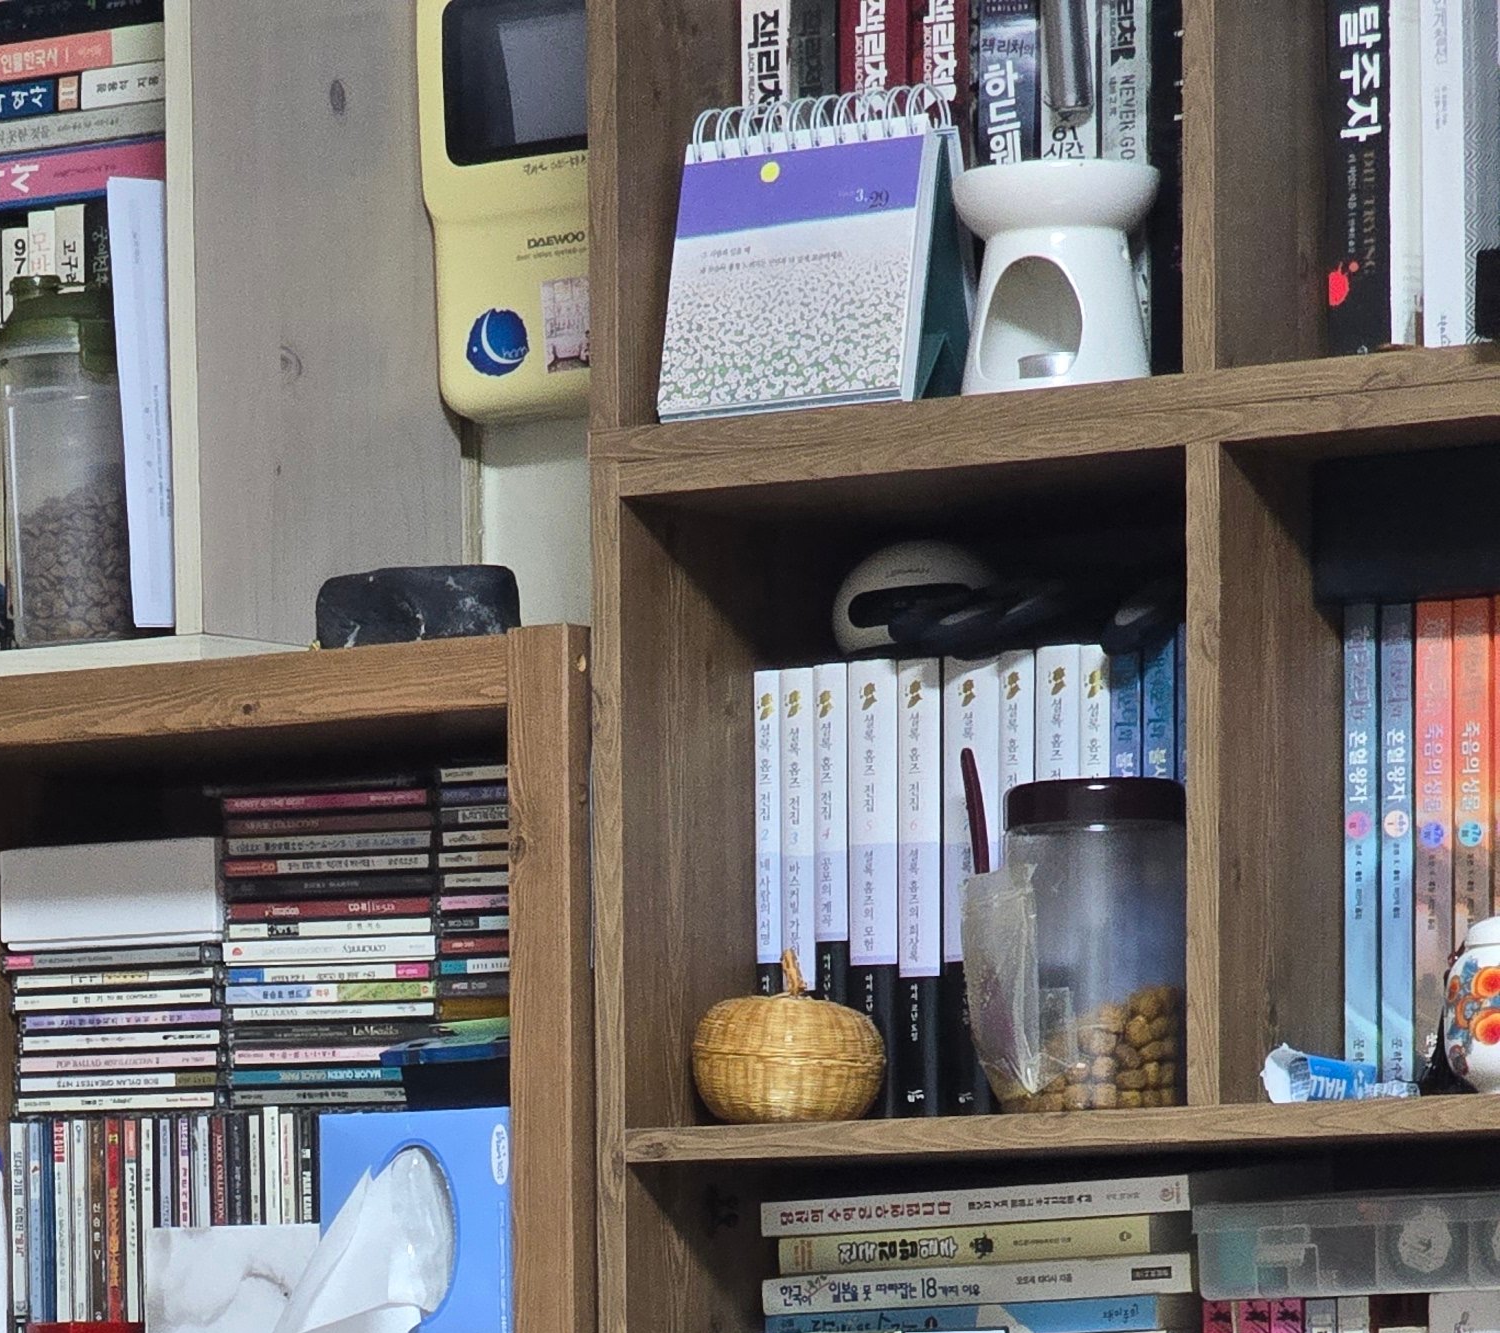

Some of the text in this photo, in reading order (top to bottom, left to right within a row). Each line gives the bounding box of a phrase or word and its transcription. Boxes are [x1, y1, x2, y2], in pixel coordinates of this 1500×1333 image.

[1339, 5, 1382, 142] 탈주자
[12, 86, 47, 109] 역사
[1119, 74, 1136, 132] NEVER
[1043, 142, 1086, 160] 시간
[1052, 125, 1079, 142] 61
[869, 190, 889, 209] 29
[527, 231, 585, 250] DAEWOO
[1349, 729, 1369, 803] 혼혈왕자
[1387, 729, 1406, 803] 혼혈왕자
[1461, 721, 1480, 774] 죽음의
[759, 758, 772, 821] 홈즈 전집
[821, 857, 833, 929] 공포의 계곡
[863, 882, 875, 921] 홈즈의
[828, 1280, 860, 1304] 일본을
